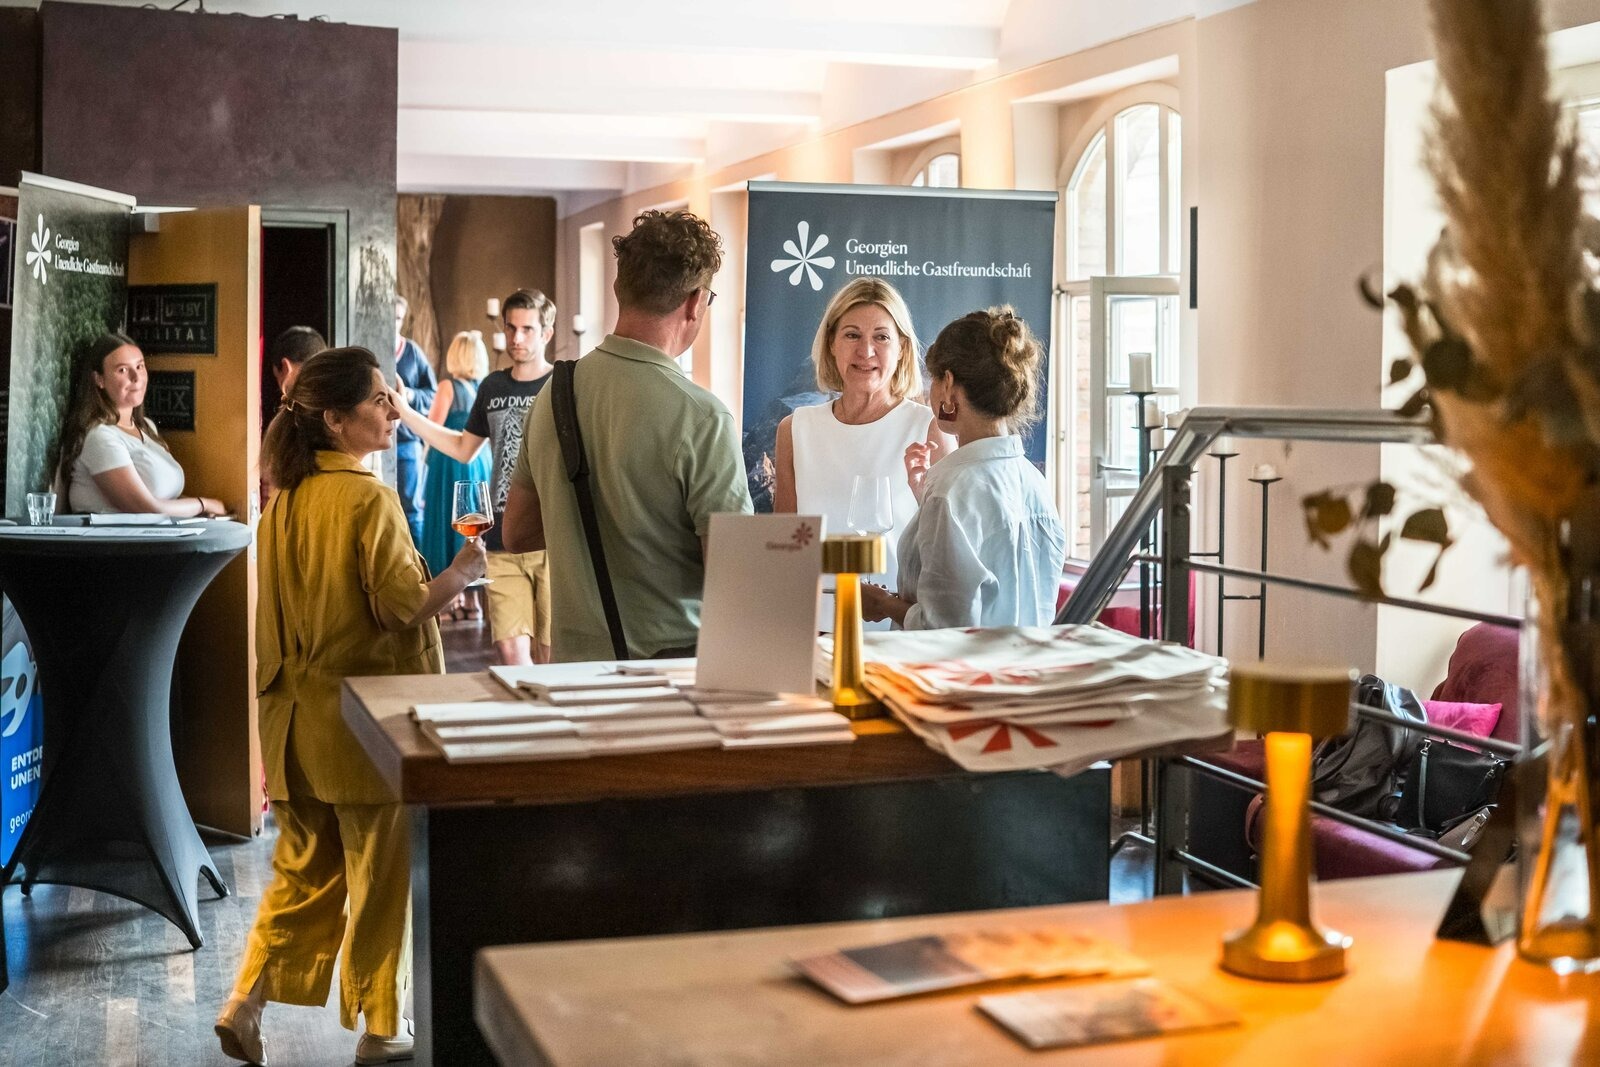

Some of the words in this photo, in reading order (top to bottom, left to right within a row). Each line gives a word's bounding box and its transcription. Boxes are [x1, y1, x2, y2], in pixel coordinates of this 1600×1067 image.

[845, 238, 908, 258] Georgien
[845, 260, 920, 277] Unendliche
[922, 261, 1032, 278] Gastfreundschaft
[486, 396, 507, 410] JOY
